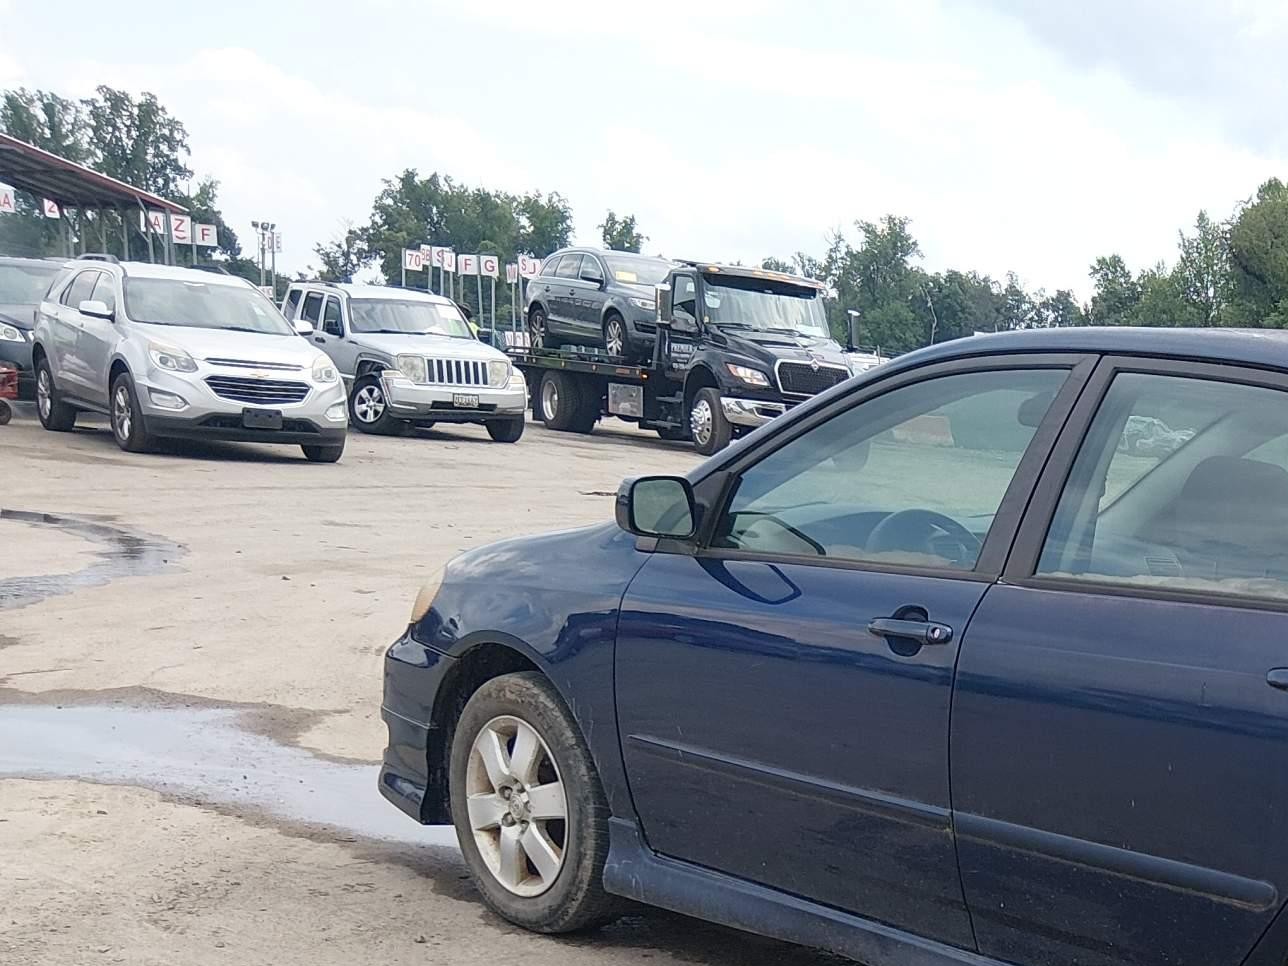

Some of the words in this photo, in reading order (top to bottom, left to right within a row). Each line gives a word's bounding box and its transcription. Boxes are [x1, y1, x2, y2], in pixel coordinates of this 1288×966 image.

[201, 228, 211, 241] F
[408, 253, 421, 267] 70
[447, 255, 453, 268] J
[464, 259, 472, 271] F
[484, 260, 495, 273] G
[521, 258, 527, 271] S
[529, 262, 537, 275] J
